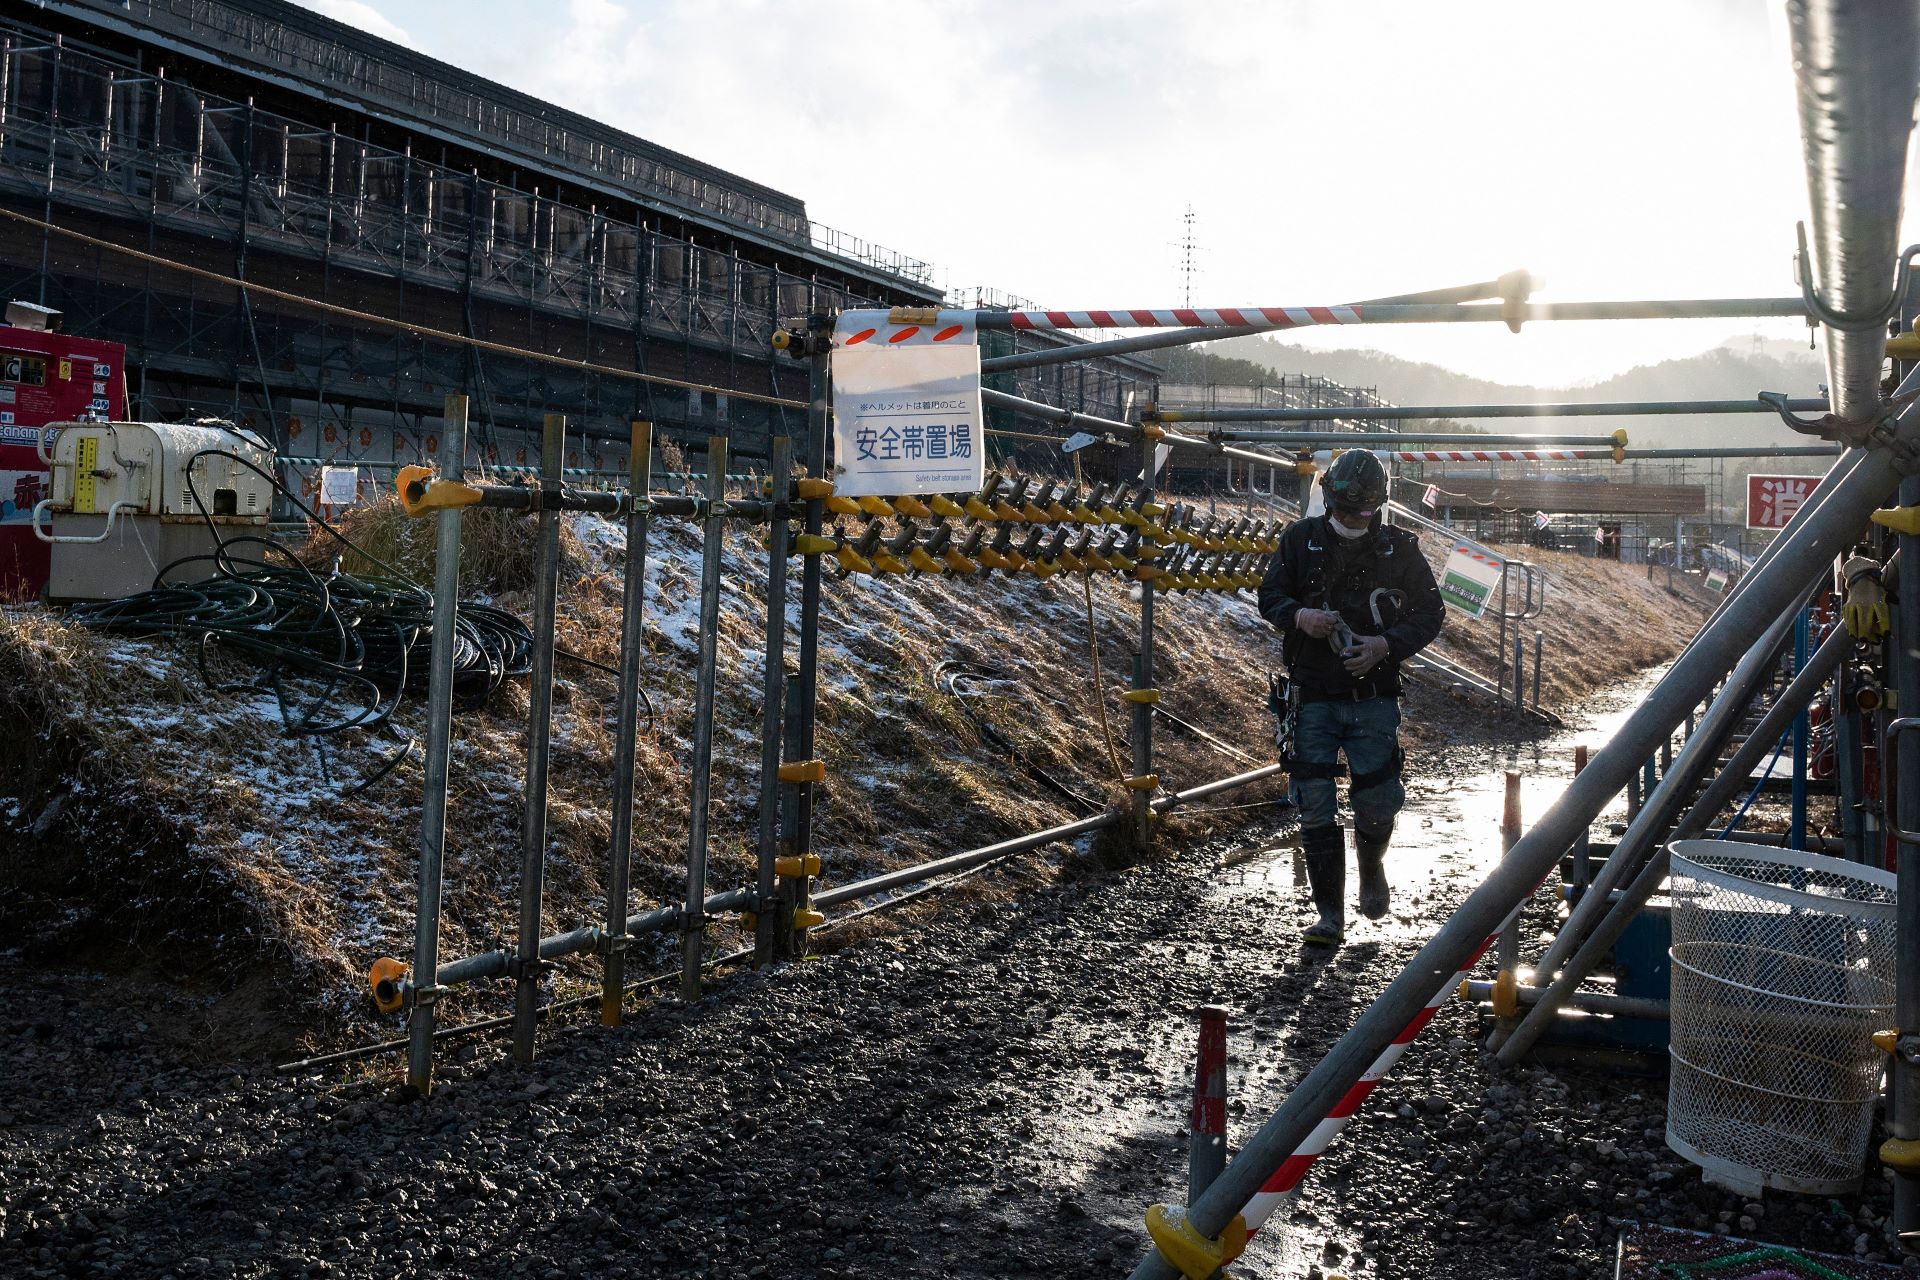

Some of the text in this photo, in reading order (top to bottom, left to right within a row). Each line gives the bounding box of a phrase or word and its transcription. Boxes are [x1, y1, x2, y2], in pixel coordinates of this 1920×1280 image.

[860, 400, 967, 412] ※ヘルメットは着用のこと
[856, 424, 972, 461] 安全帯置場
[915, 474, 932, 482] Safety
[1759, 480, 1807, 526] 消
